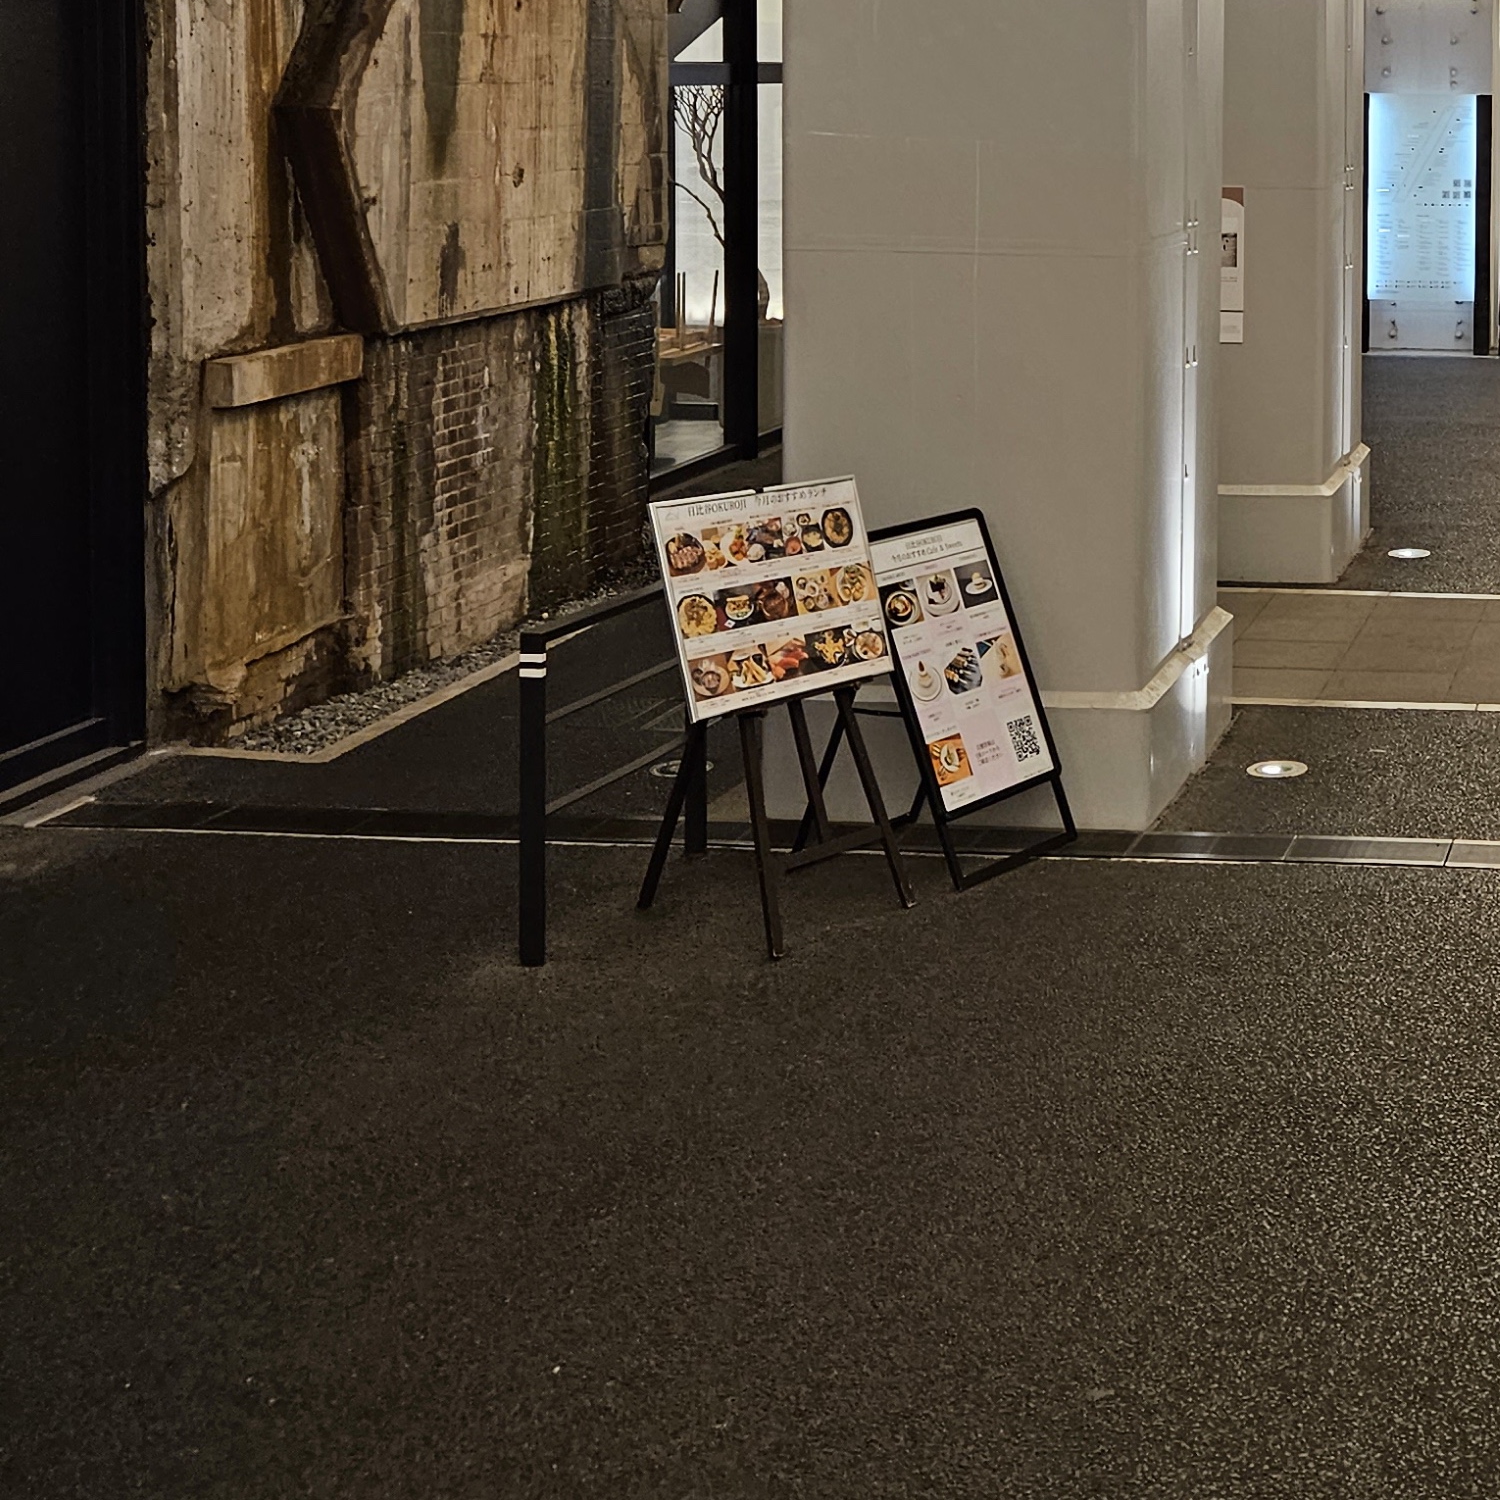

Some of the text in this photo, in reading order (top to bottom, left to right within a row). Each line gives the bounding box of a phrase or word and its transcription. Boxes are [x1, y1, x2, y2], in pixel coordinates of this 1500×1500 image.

[687, 488, 828, 518] 日比谷OKUROJI 今月のおすすめランチ
